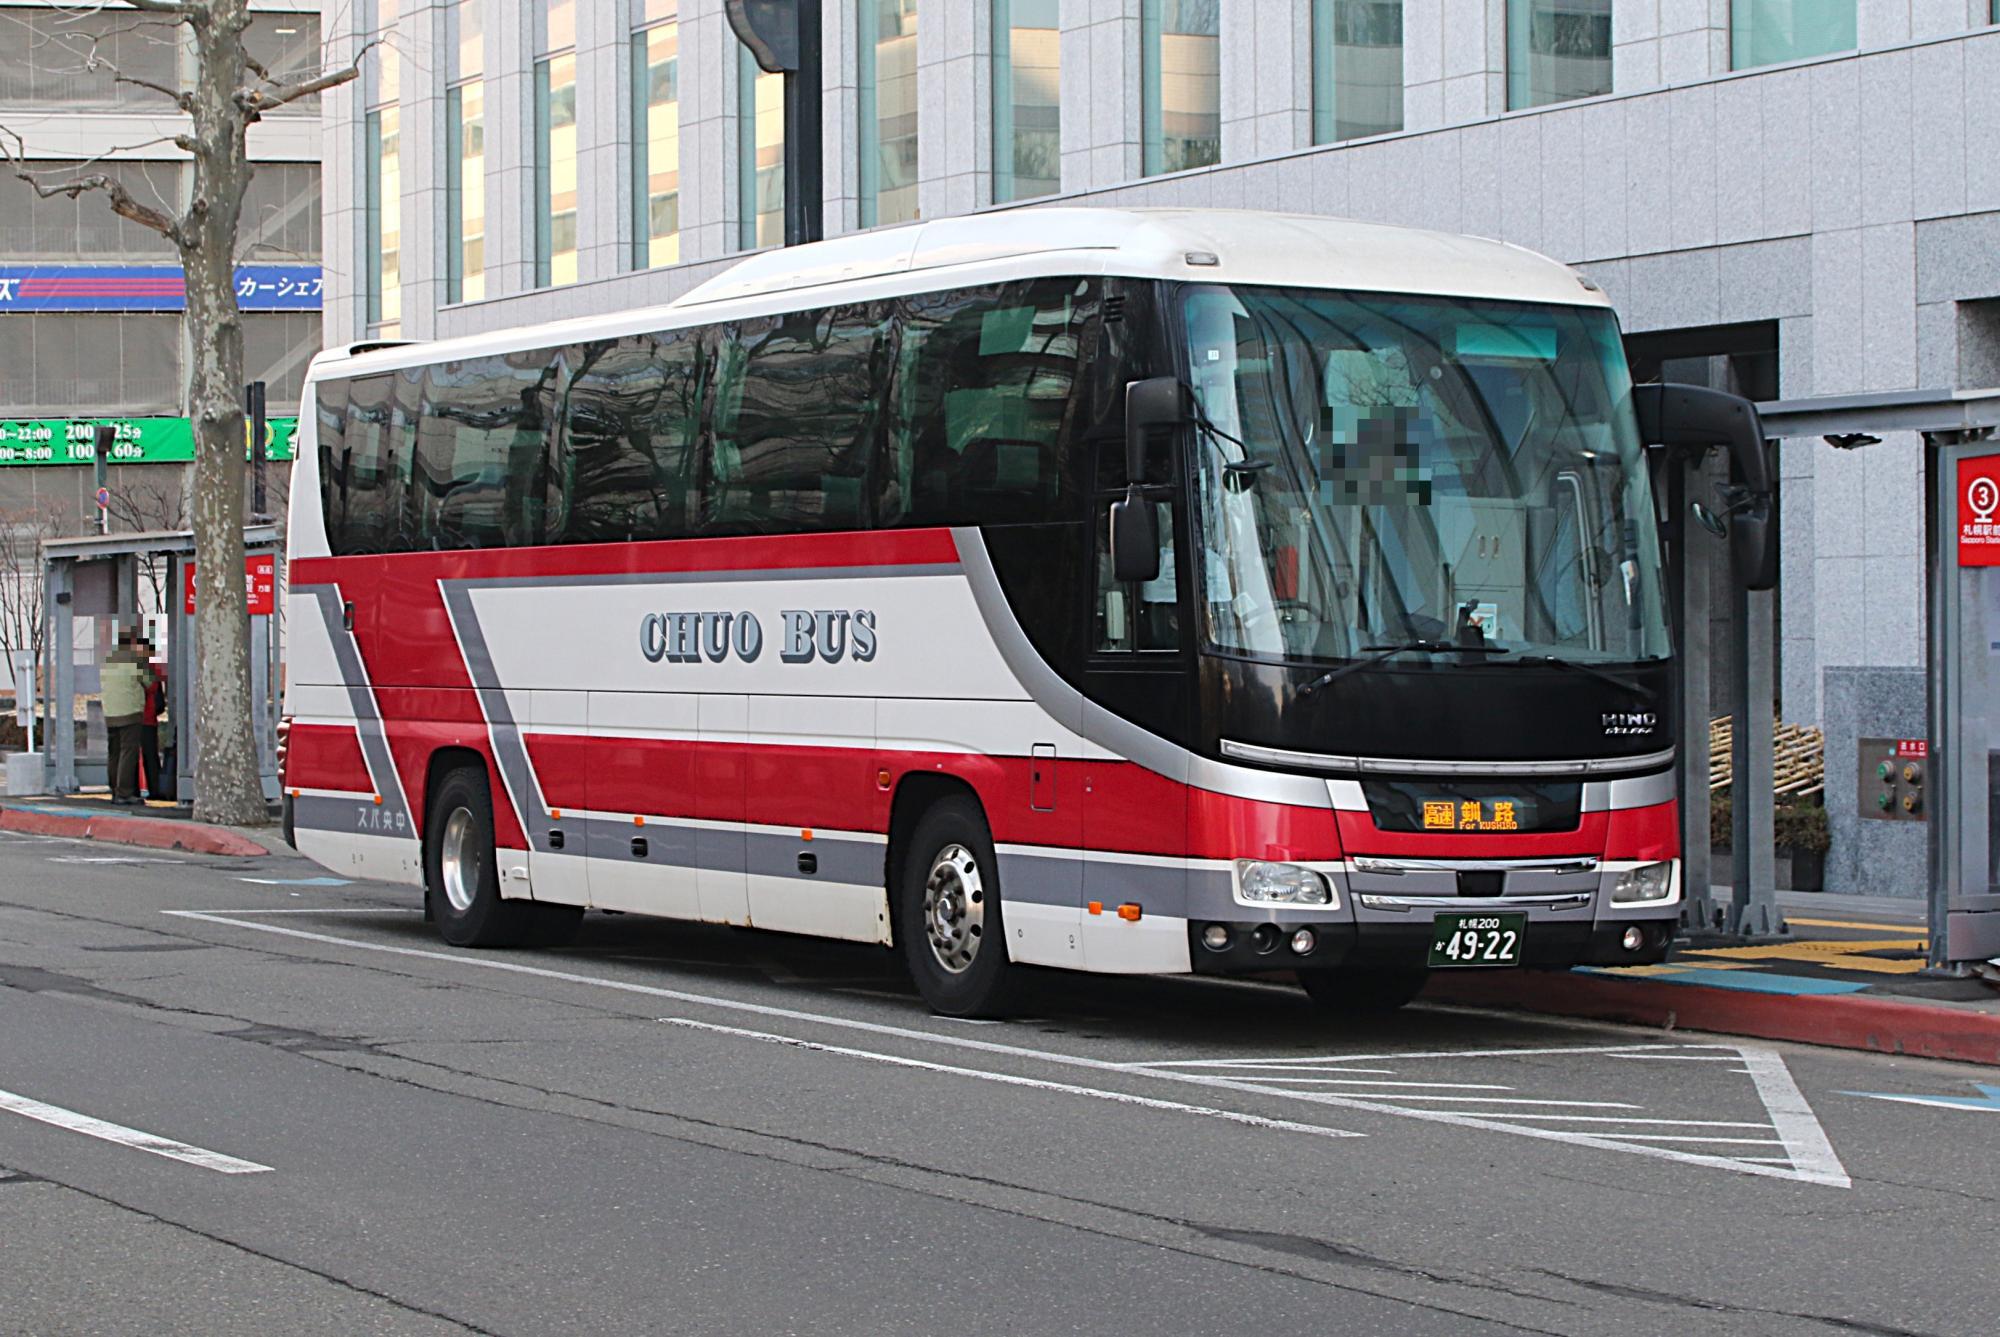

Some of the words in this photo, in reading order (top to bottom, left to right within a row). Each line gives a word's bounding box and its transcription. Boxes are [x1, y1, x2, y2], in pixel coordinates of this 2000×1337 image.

[1978, 486, 1988, 506] 3
[640, 610, 763, 664] CHUO
[780, 609, 877, 664] BUS
[1602, 713, 1656, 726] HINO
[1425, 805, 1453, 825] 高速
[1460, 821, 1476, 830] For
[1480, 821, 1518, 830] KUSHIRO
[1446, 930, 1517, 960] 49-22
